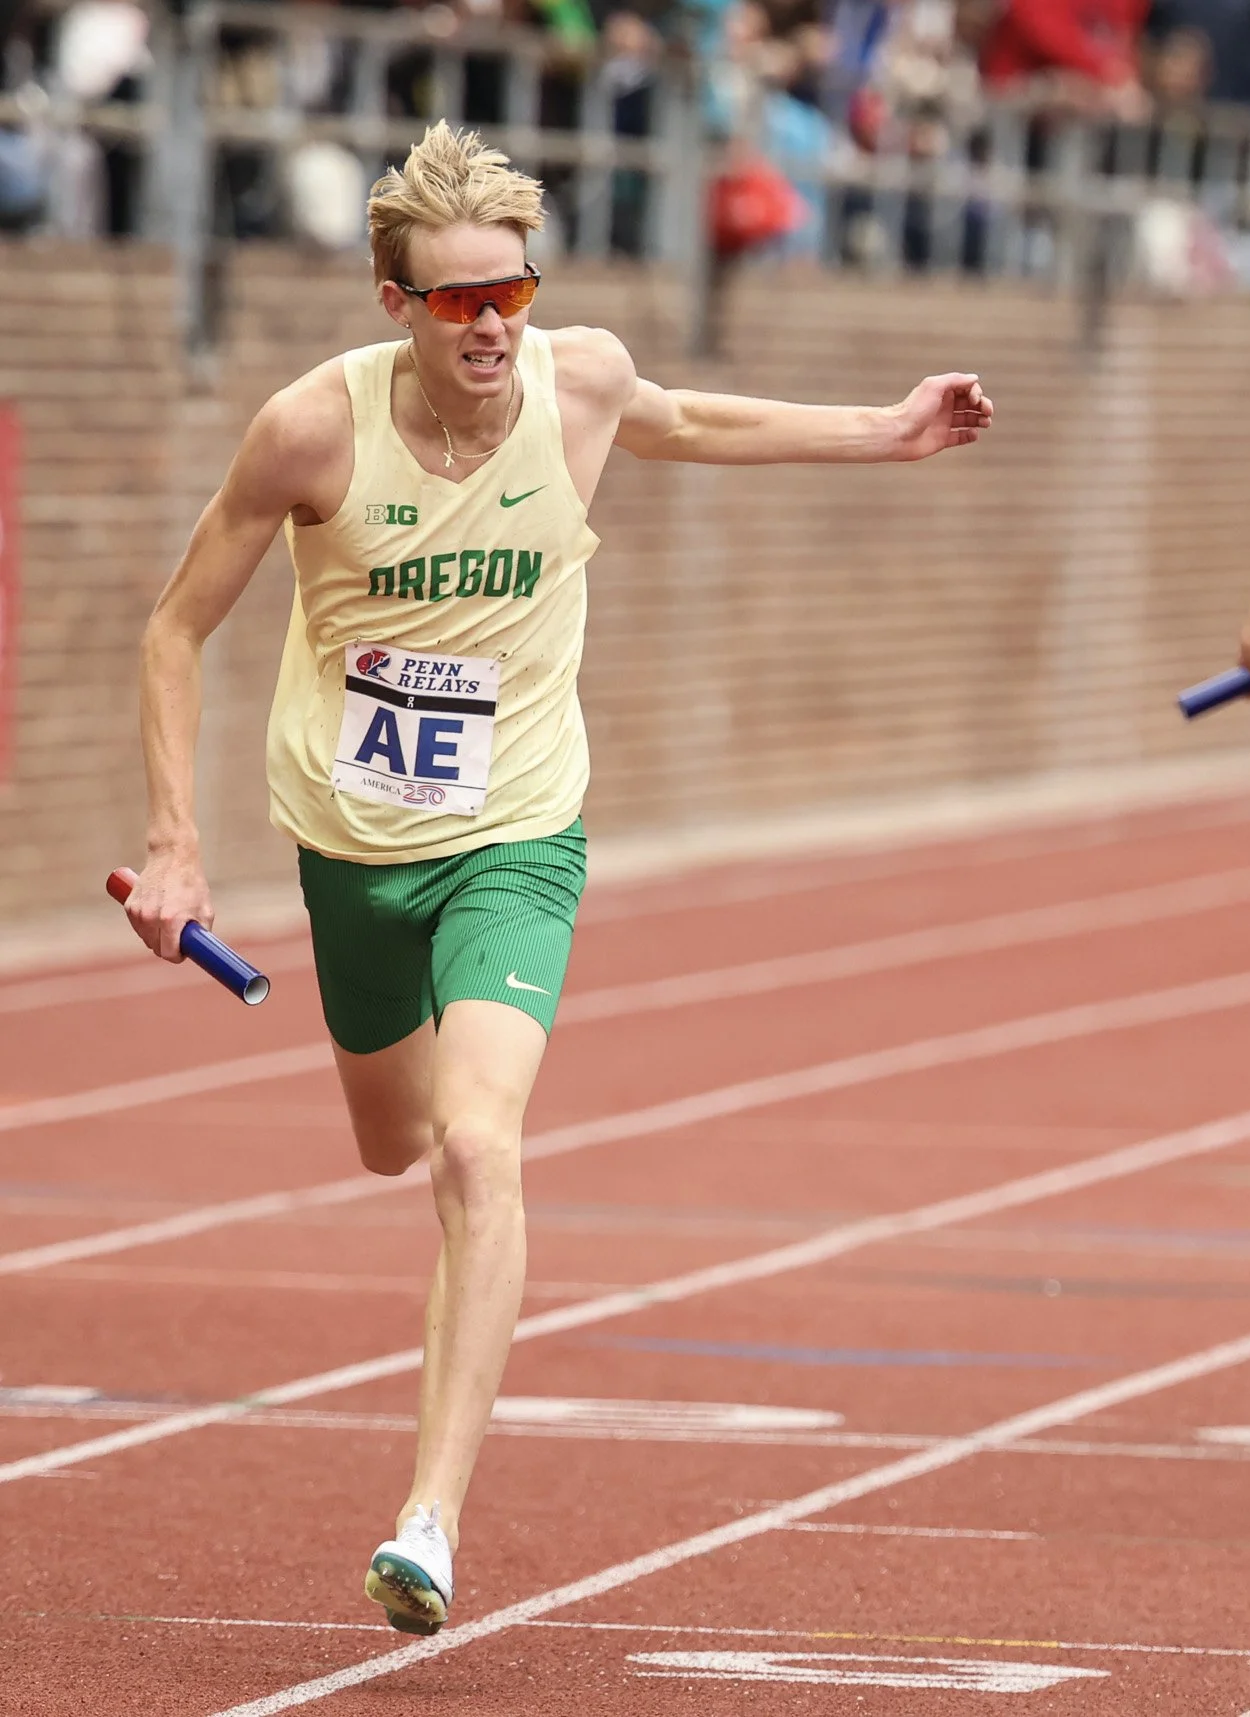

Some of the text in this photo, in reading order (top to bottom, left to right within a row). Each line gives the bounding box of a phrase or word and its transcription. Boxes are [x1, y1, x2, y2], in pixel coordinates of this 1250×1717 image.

[368, 549, 543, 603] OREGON
[401, 658, 464, 677] PENN
[397, 673, 480, 694] RELAYS
[354, 706, 464, 781] AE
[360, 777, 446, 806] AMERICA 250
